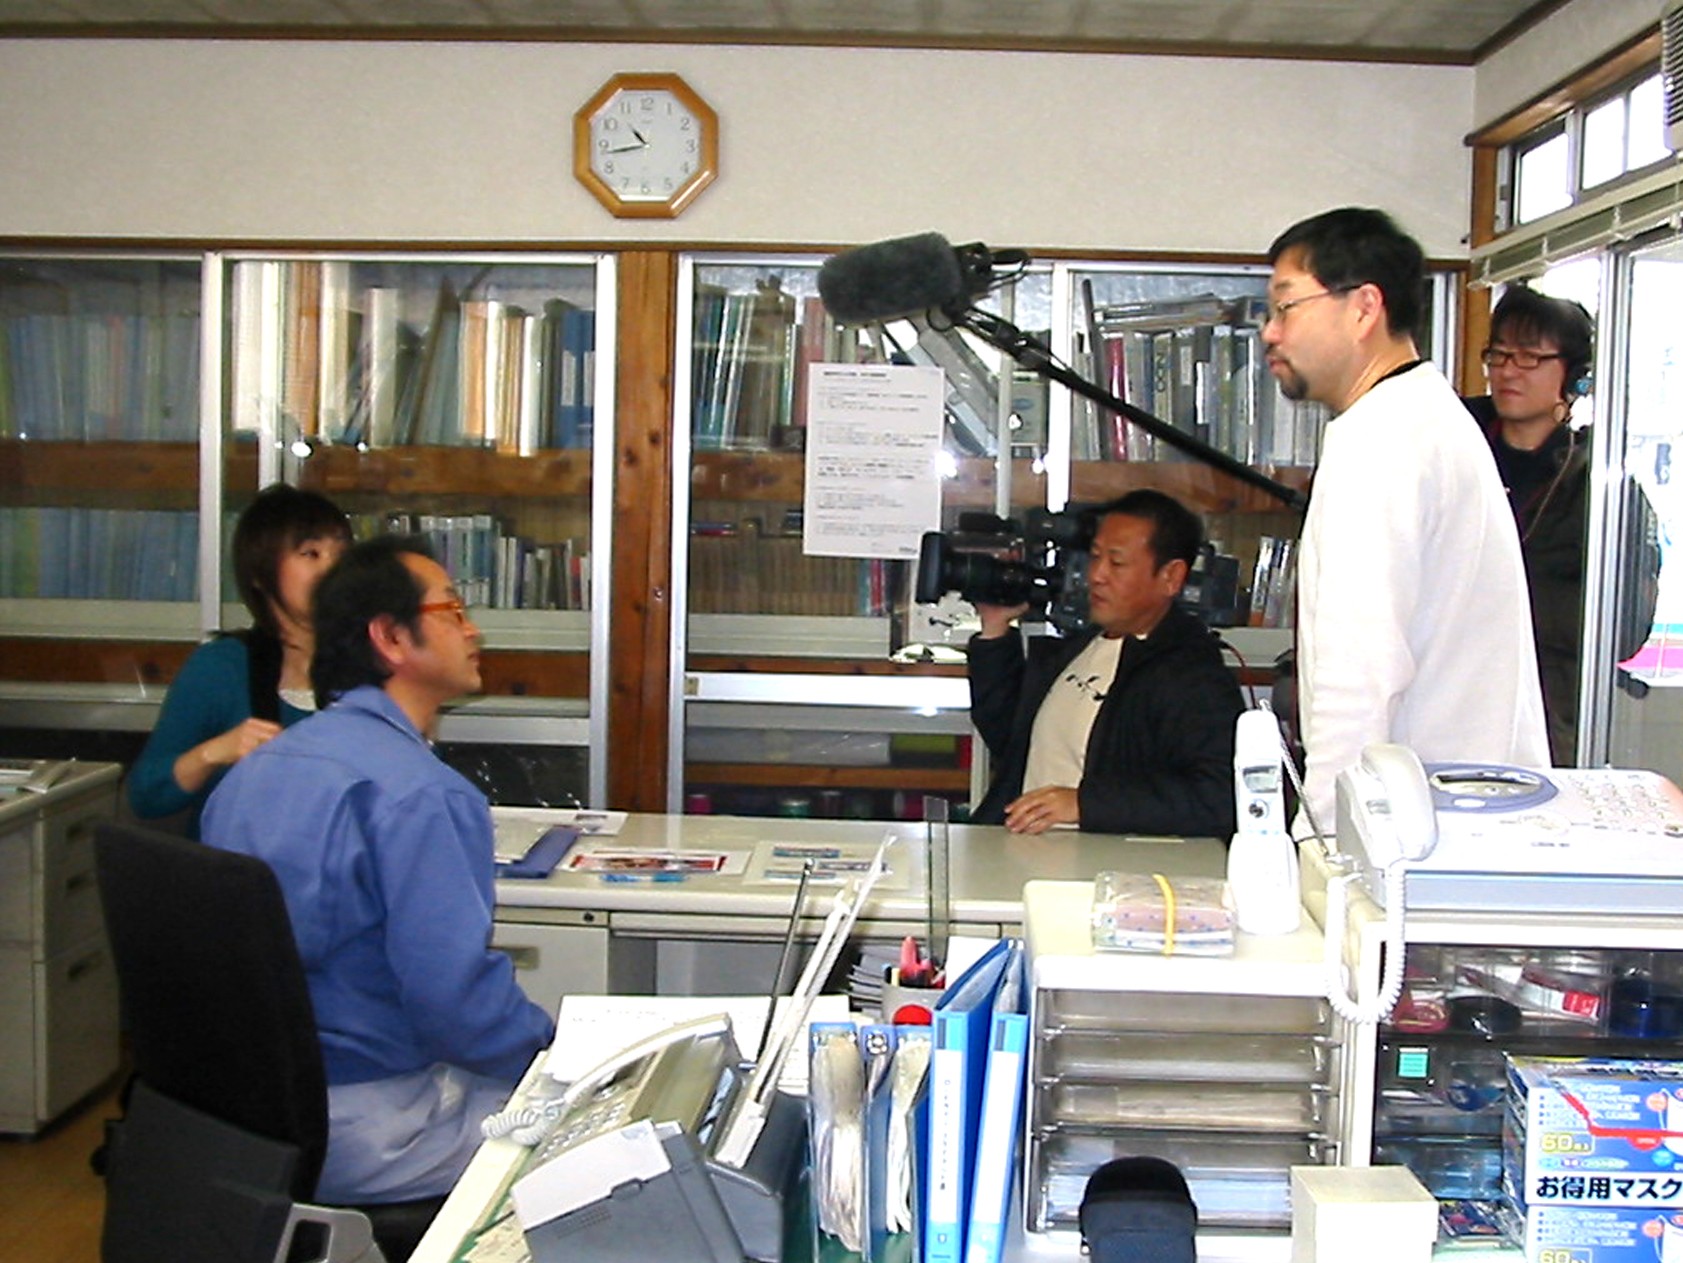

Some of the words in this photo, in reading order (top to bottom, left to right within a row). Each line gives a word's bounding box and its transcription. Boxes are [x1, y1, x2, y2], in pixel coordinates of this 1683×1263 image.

[620, 102, 631, 114] 11
[640, 97, 654, 111] 12
[666, 103, 672, 115] 1
[603, 118, 618, 131] 10
[680, 118, 690, 131] 2
[598, 138, 609, 153] 9
[686, 139, 695, 153] 3
[603, 161, 614, 174] 8
[680, 162, 689, 174] 4
[622, 177, 630, 189] 7
[640, 182, 651, 195] 6
[664, 177, 673, 190] 5
[1536, 1176, 1682, 1199] お得用マスク
